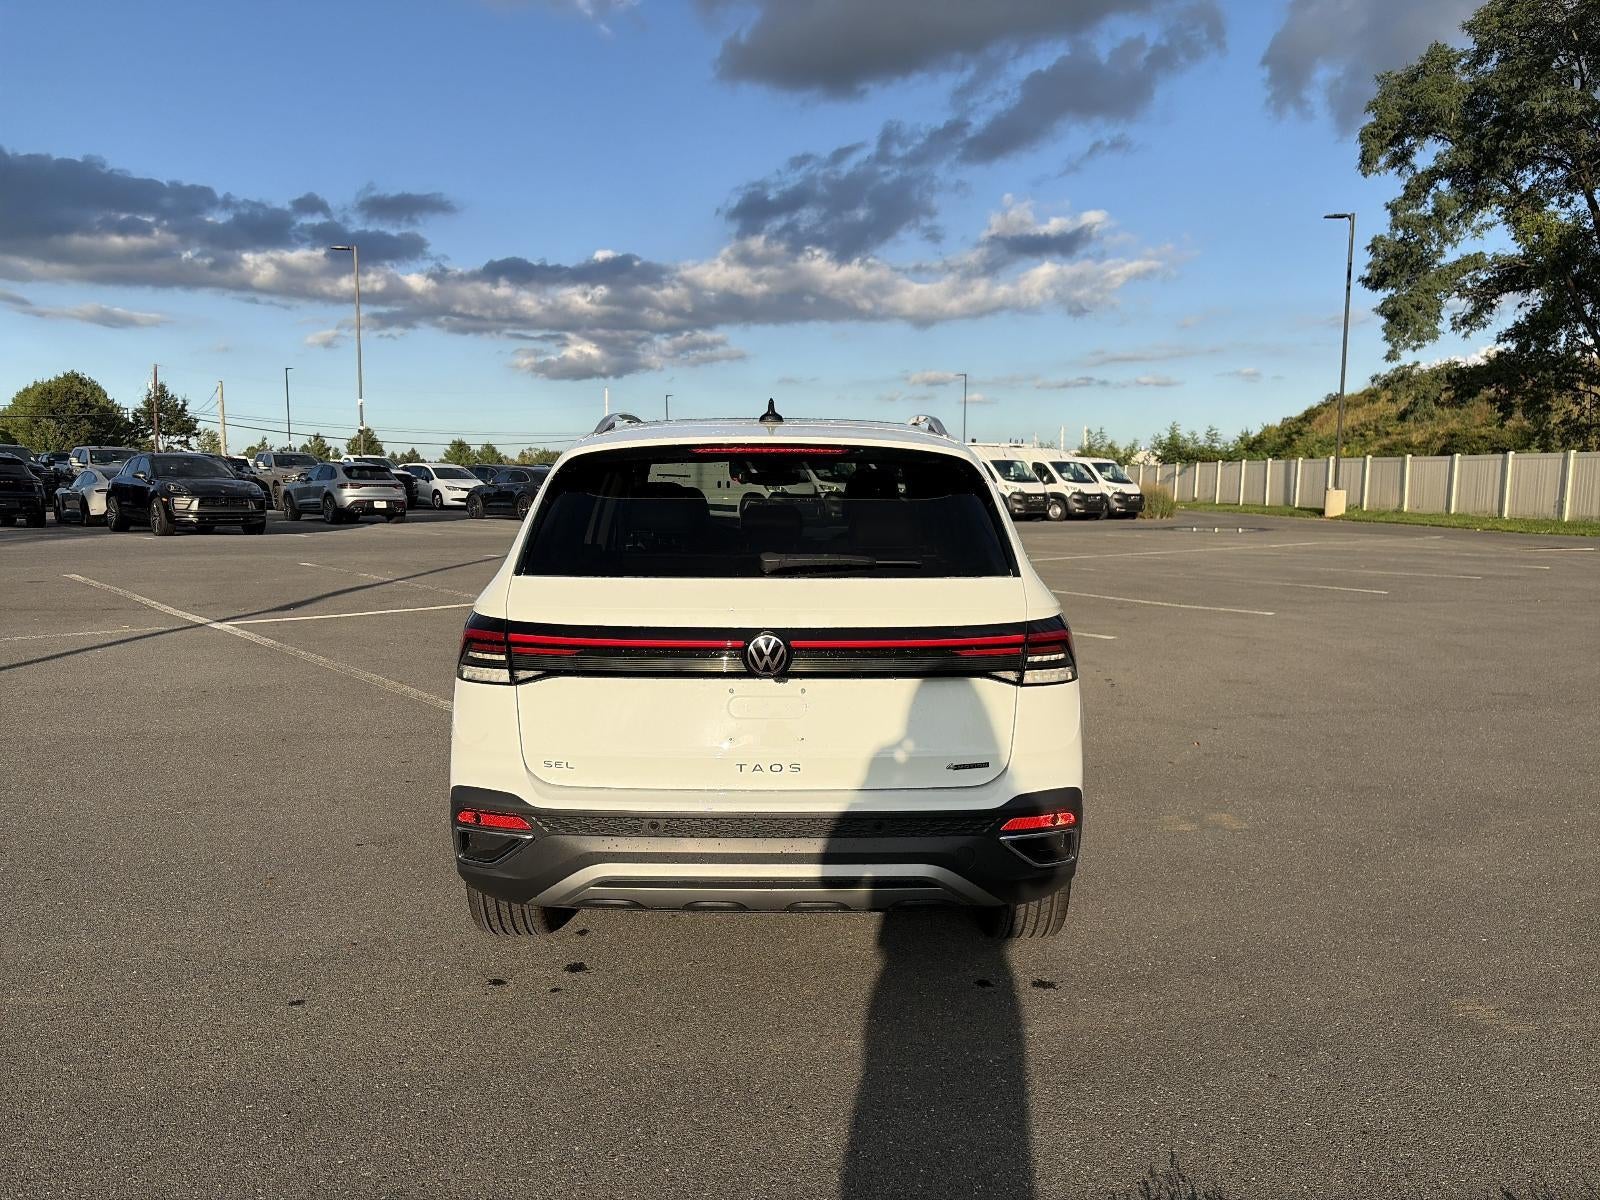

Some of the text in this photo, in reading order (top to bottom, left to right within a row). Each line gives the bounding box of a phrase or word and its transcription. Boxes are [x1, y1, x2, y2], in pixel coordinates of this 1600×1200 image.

[749, 637, 785, 671] VW
[543, 760, 576, 770] SEL
[736, 763, 801, 773] TAOS
